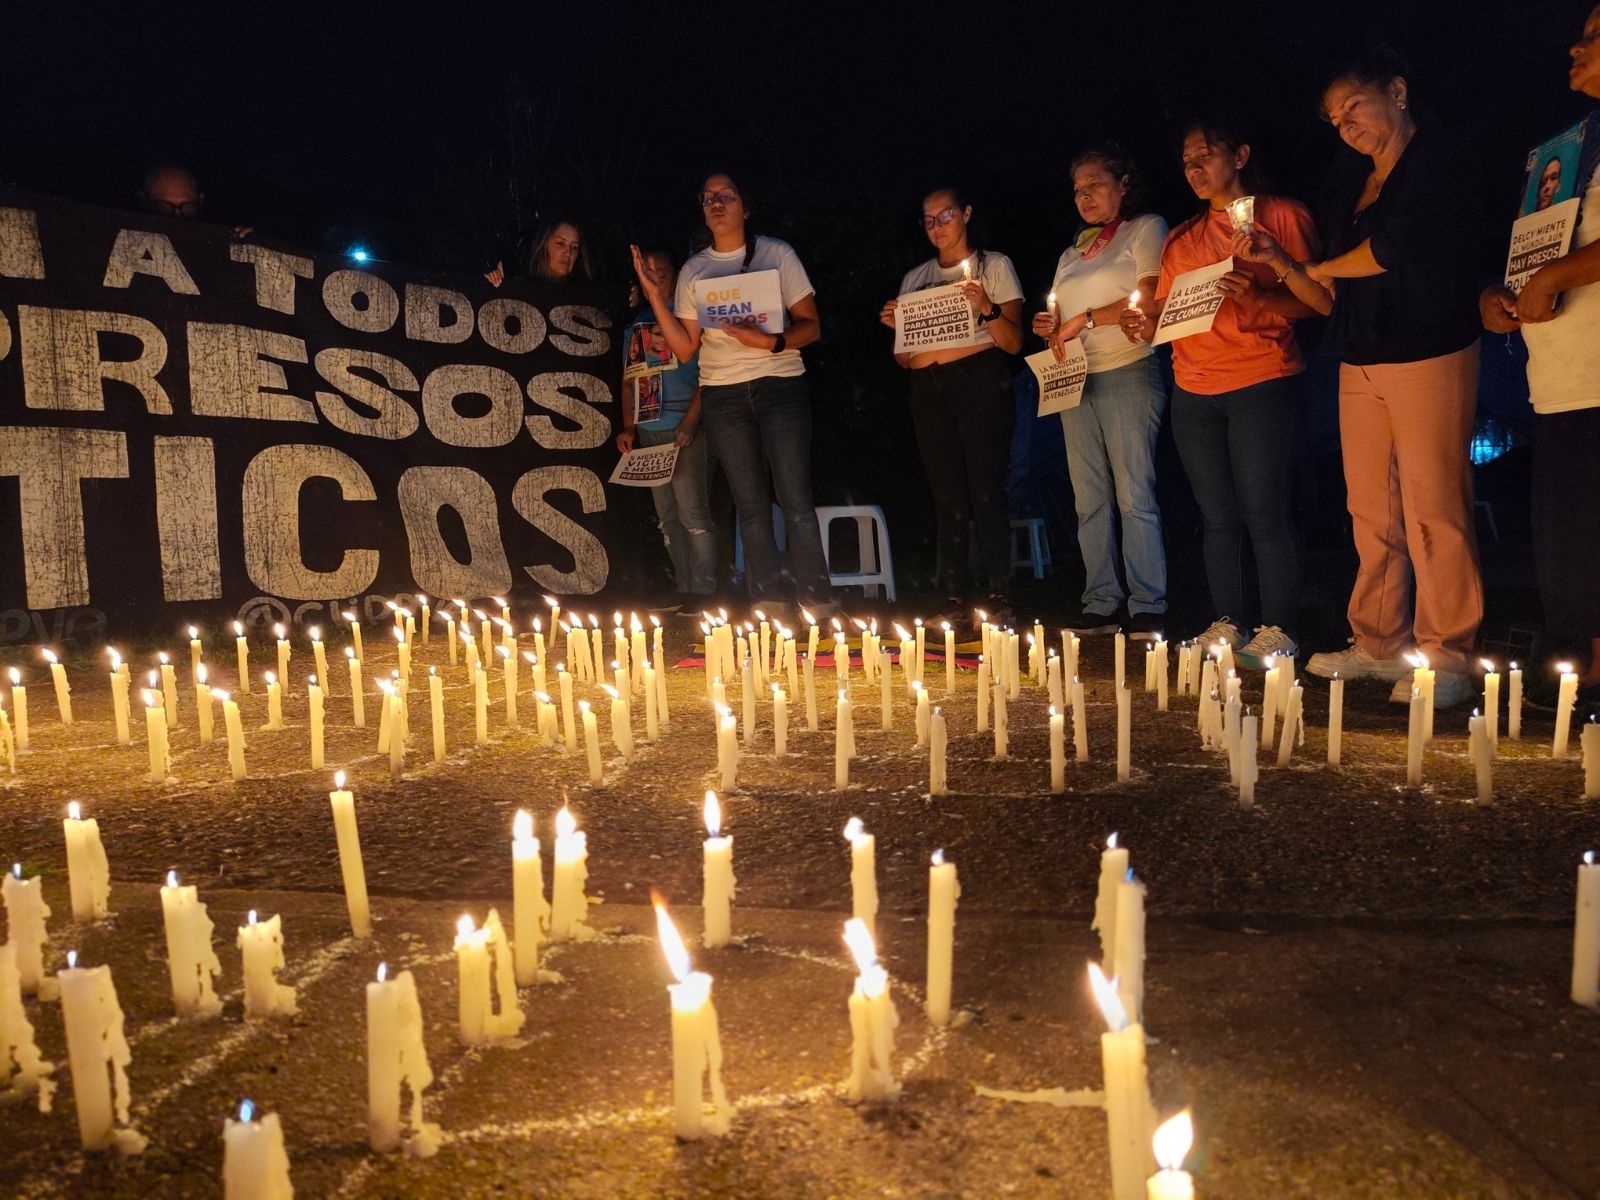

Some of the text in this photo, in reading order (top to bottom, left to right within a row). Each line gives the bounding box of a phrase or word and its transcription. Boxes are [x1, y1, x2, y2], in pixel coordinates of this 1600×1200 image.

[1513, 219, 1566, 245] DELCY MIENTE
[1510, 246, 1559, 273] HAY PRESOS
[102, 228, 201, 296] A
[230, 241, 613, 358] TODOS
[707, 288, 742, 304] QUE
[1167, 289, 1217, 310] NO SE ANUNC
[1172, 289, 1182, 300] LA
[707, 302, 752, 315] SEAN
[903, 296, 966, 315] NO INVESTIGA
[904, 303, 967, 322] SIMULA HACERLO
[1162, 300, 1219, 325] SE CUMPLE
[707, 312, 768, 325] TODOS
[905, 312, 968, 330] PARA FABRICAR
[904, 322, 970, 341] TITULARES
[936, 332, 970, 343] MEDIOS
[0, 304, 614, 450] RESOS
[1038, 366, 1048, 374] LA
[1043, 364, 1086, 381] PENITENCIARIA
[1057, 374, 1085, 388] MATANDO
[1050, 385, 1081, 400] VENEZUELA
[628, 455, 675, 467] VIGILIA
[637, 451, 664, 461] MESES
[621, 468, 672, 480] RESISTENCIA
[632, 464, 662, 473] MESES
